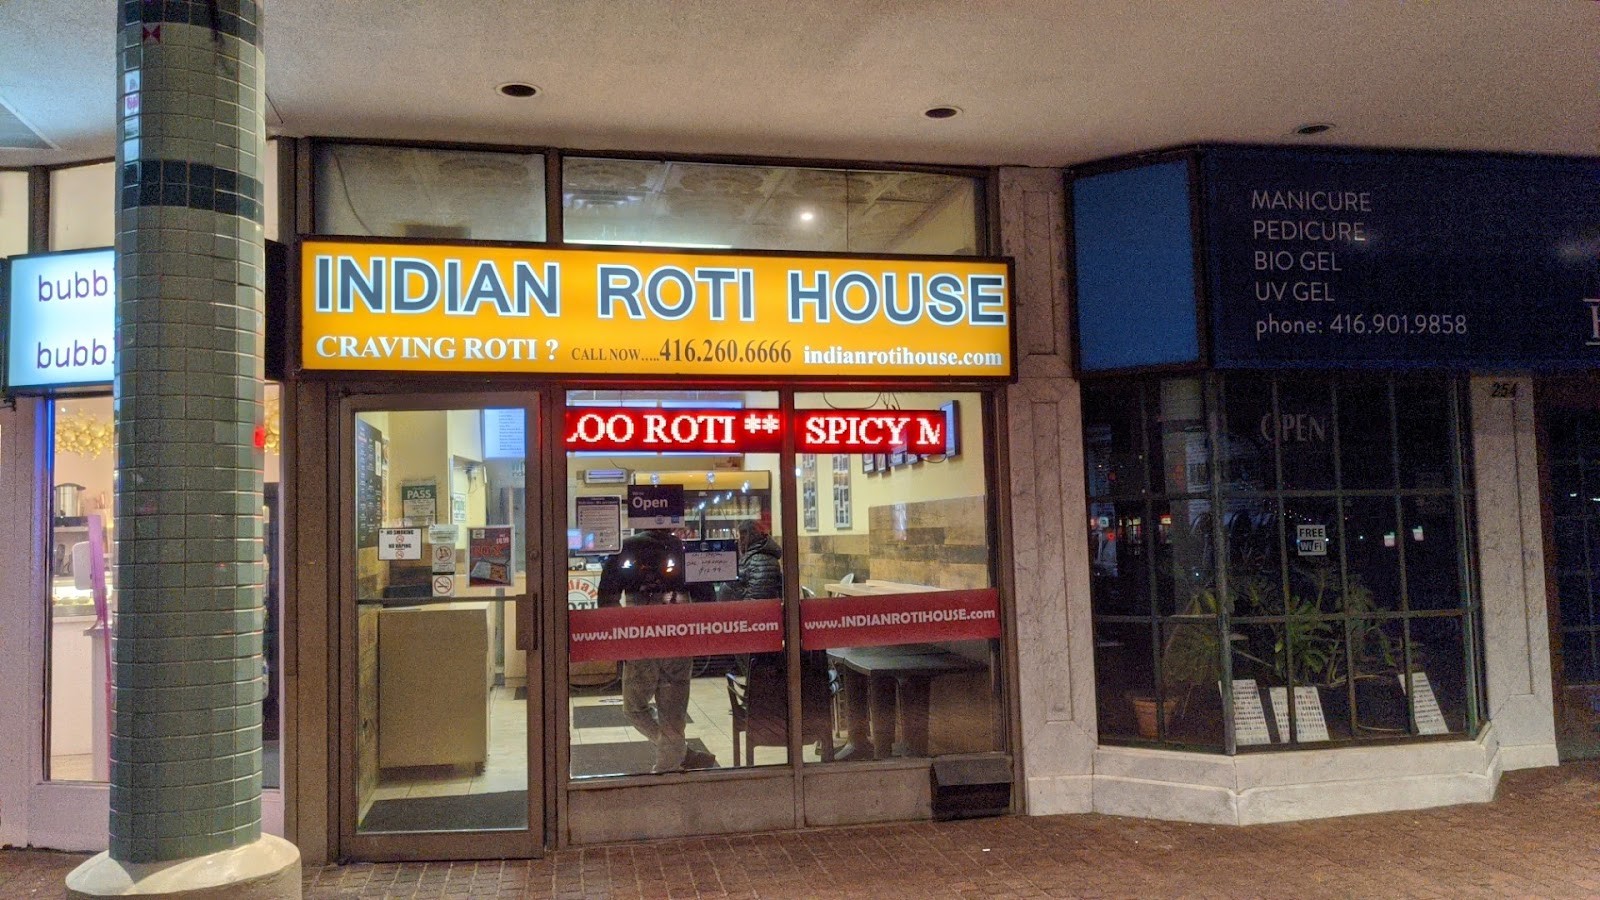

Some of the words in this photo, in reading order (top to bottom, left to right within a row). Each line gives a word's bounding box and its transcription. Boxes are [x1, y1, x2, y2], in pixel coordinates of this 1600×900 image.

[1251, 190, 1372, 212] MANICURE
[1253, 221, 1366, 241] PEDICURE
[1254, 251, 1293, 271] BIO
[1300, 252, 1342, 271] GEL
[38, 269, 116, 302] bubb
[315, 255, 560, 317] INDIAN
[597, 264, 755, 321] ROTI
[787, 270, 1007, 326] HOUSE
[1255, 282, 1286, 301] UV
[1293, 282, 1335, 301] GEL
[1256, 314, 1323, 341] phone:
[1330, 314, 1467, 335] 416.901.9858
[36, 338, 116, 369] bubb
[316, 335, 455, 359] CRAVING
[463, 337, 537, 360] ROTI
[546, 340, 559, 361] ?
[572, 348, 607, 361] CALL
[803, 345, 1003, 366] indianrotihouse.com
[566, 413, 634, 443] OO
[643, 415, 736, 443] ROTI
[806, 417, 911, 444] SPICY
[1261, 413, 1325, 441] OPEN
[407, 489, 432, 499] PASS
[632, 496, 668, 511] Open
[1299, 528, 1323, 538] FREE
[804, 609, 996, 630] www.INDIANROTIHOUSE.com
[572, 620, 779, 642] www.INDIANROTIHOUSE.com
